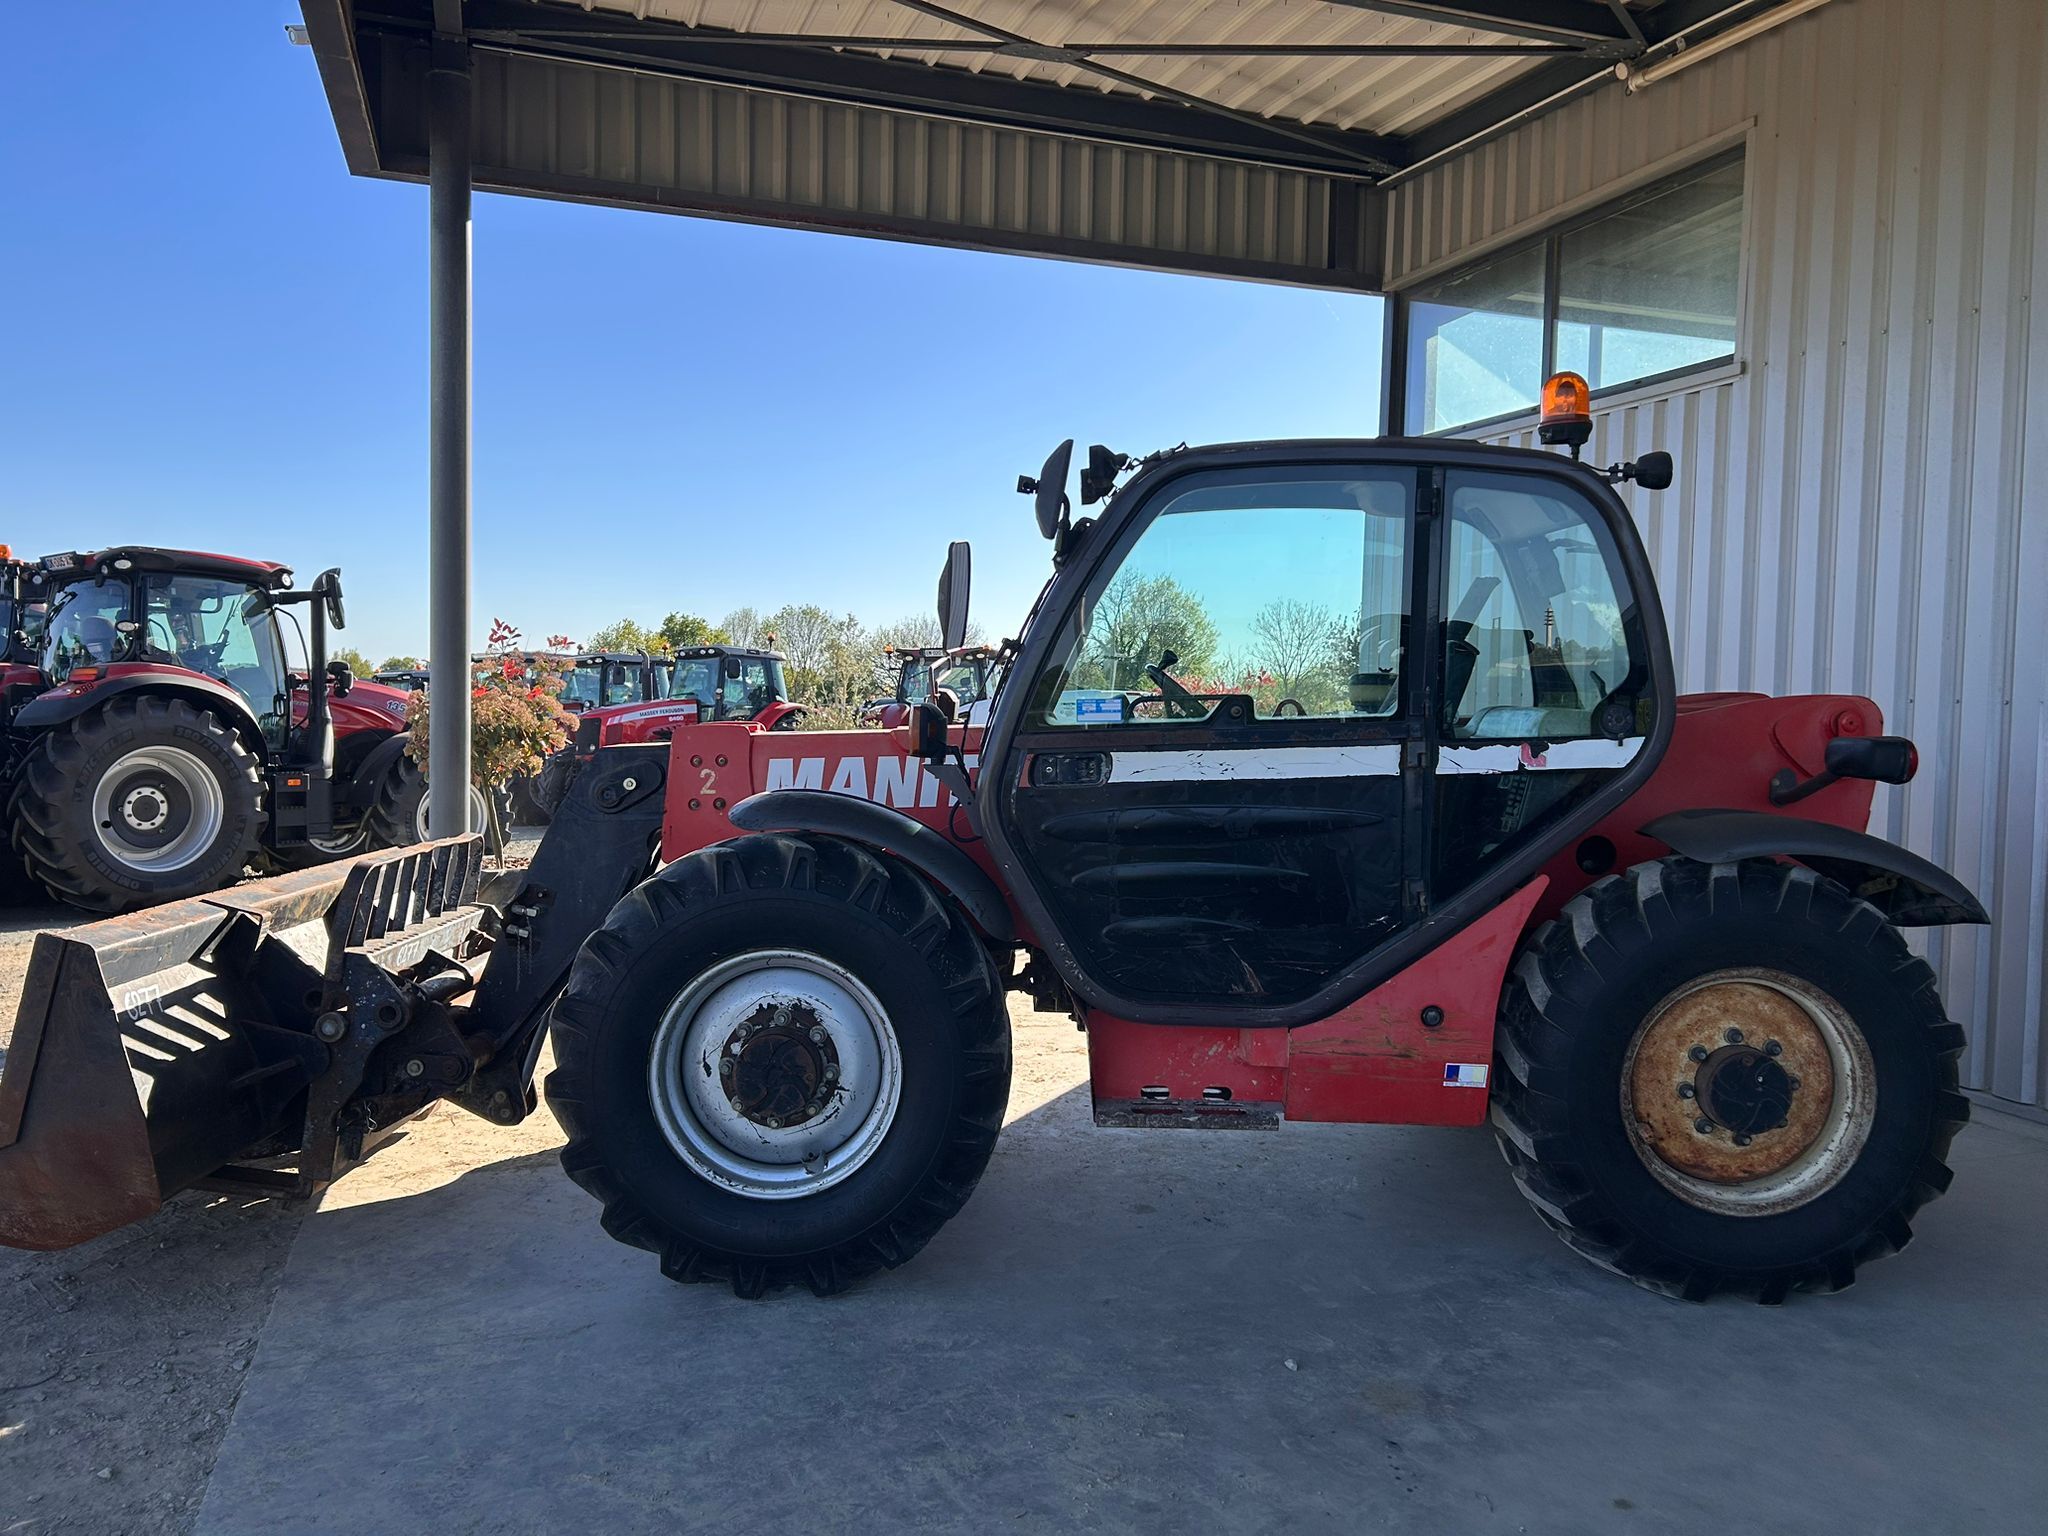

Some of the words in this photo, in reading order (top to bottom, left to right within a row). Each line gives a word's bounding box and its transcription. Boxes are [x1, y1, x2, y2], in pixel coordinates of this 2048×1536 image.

[386, 700, 407, 713] 135
[639, 709, 659, 717] MASSEY
[699, 768, 717, 795] 2
[124, 983, 164, 1021] 6277
